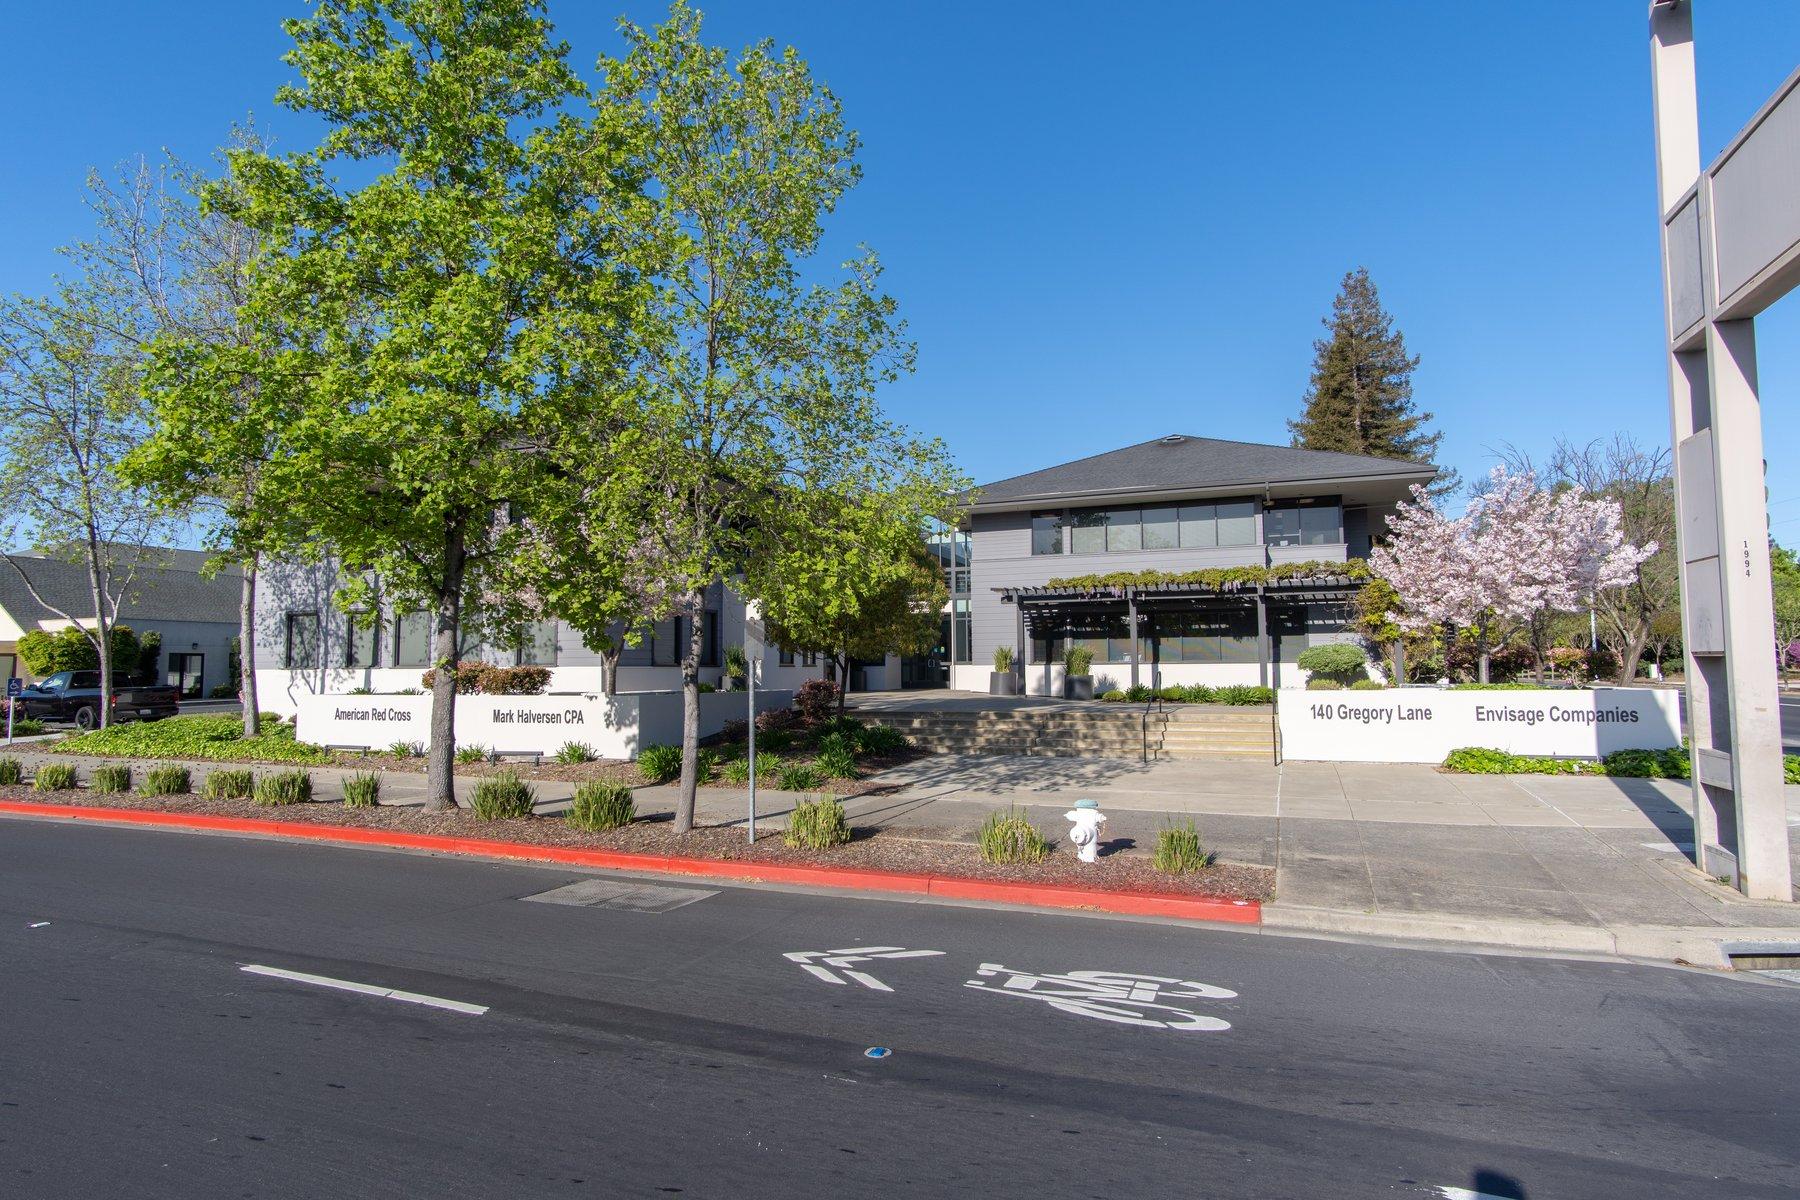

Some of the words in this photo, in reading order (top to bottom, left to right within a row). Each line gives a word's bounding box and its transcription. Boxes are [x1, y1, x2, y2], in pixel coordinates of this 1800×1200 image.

[1743, 540, 1751, 577] 1994
[334, 707, 369, 721] American
[371, 707, 386, 722] Red
[388, 708, 412, 722] Cross
[492, 709, 514, 723] Mark
[517, 709, 562, 724] Halversen
[564, 710, 584, 725] CPA
[1310, 704, 1333, 721] 140
[1337, 703, 1393, 724] Gregory
[1397, 704, 1433, 721] Lane
[1475, 705, 1545, 726] Envisage
[1549, 705, 1640, 727] Companies
